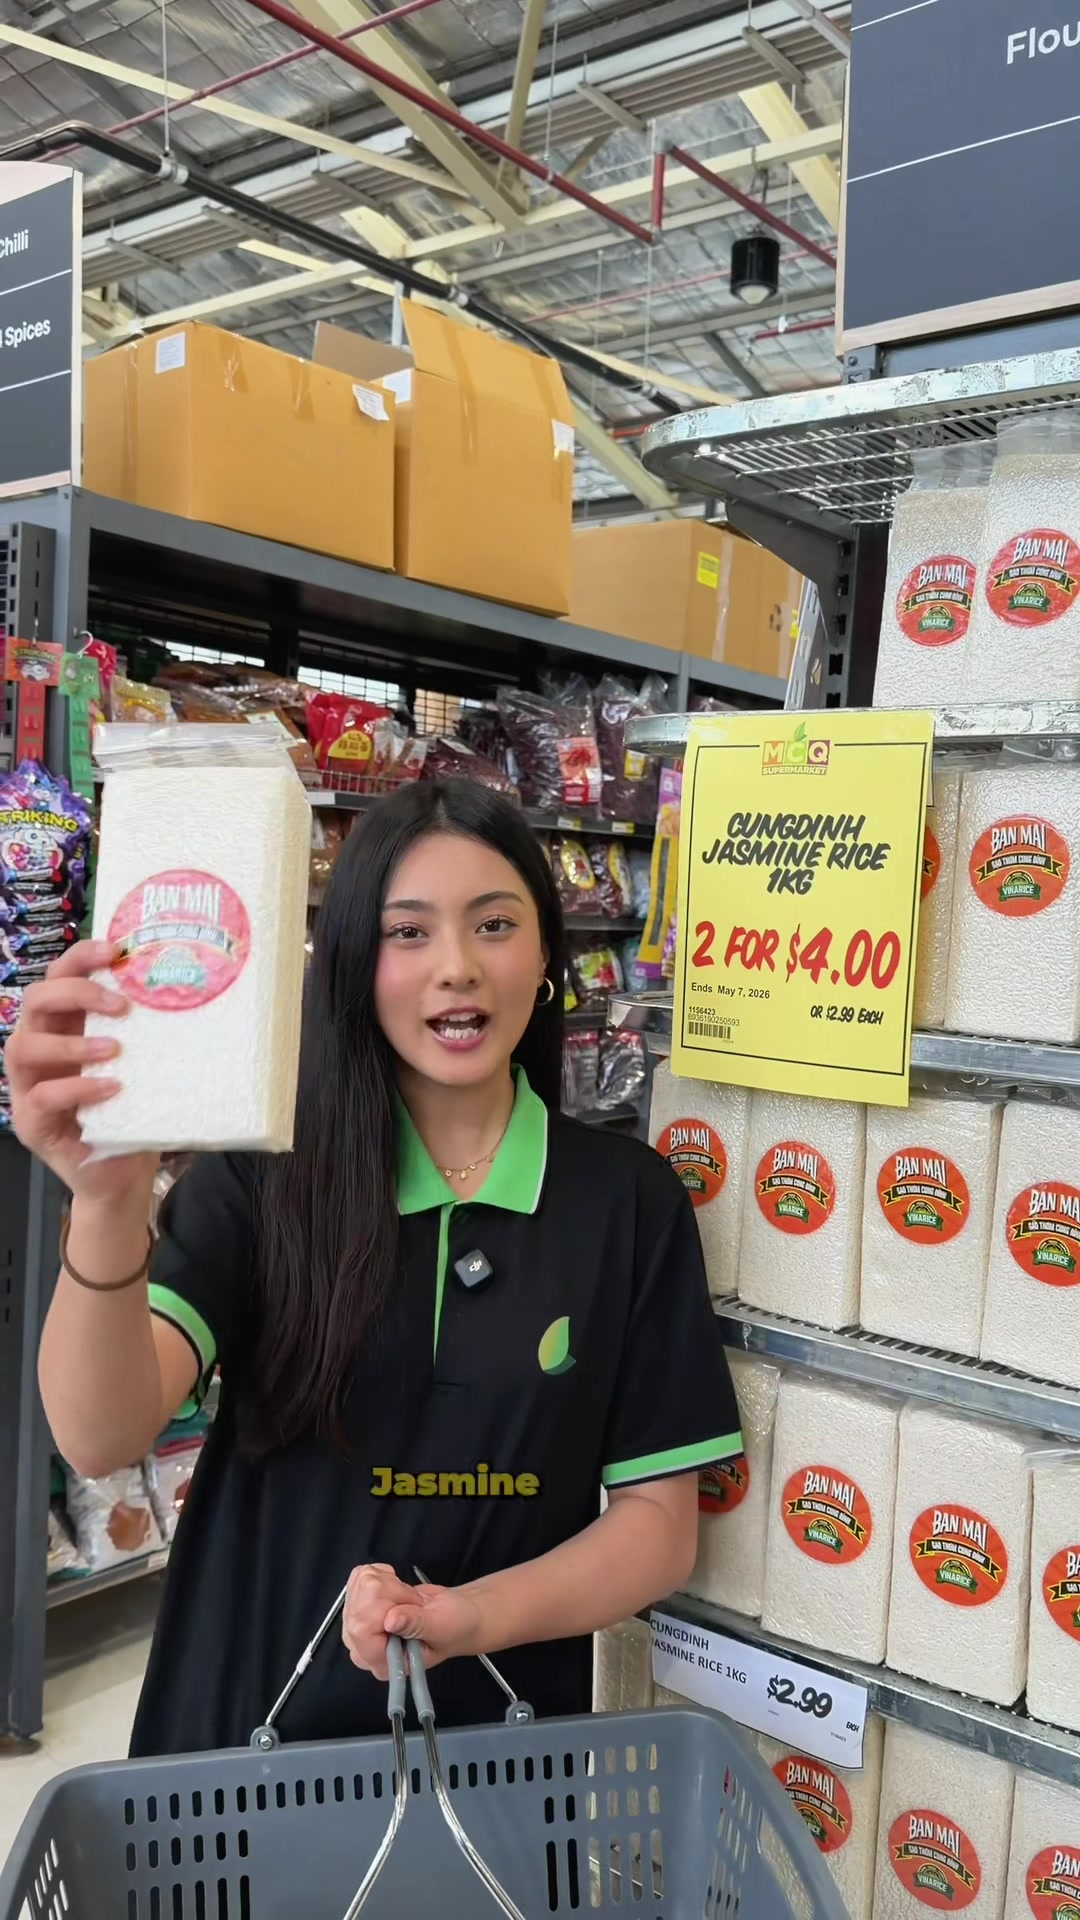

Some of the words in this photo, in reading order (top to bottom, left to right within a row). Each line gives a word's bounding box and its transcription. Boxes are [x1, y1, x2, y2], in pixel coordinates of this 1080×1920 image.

[1007, 21, 1080, 65] Flou
[5, 319, 51, 348] Spices
[1013, 538, 1042, 563] BAN
[1044, 538, 1069, 567] MAI
[918, 565, 943, 590] BAN
[944, 564, 967, 590] MAI
[1013, 595, 1044, 607] VINARICE
[922, 618, 950, 628] VINARICE
[763, 740, 829, 765] MCQ
[762, 766, 826, 775] SUPERMARKET
[0, 810, 79, 833] TRIKING
[727, 812, 866, 842] CUNGDINH
[990, 826, 1018, 855] BAN
[1020, 824, 1046, 852] MAI
[702, 839, 825, 867] JASMINE
[826, 842, 891, 871] RICE
[767, 868, 814, 895] 1KG
[1002, 886, 1034, 895] VINARICE
[143, 884, 181, 927] BAN
[184, 883, 221, 927] MAI
[692, 921, 715, 967] 2
[724, 926, 780, 972] FOR
[786, 923, 901, 989] $4.00
[691, 982, 713, 993] Ends
[718, 985, 736, 998] May
[738, 988, 746, 998] 7,
[748, 988, 770, 999] 2026
[688, 1013, 740, 1026] 8936190250593
[689, 1006, 716, 1016] 1156423
[810, 1005, 823, 1018] OR
[826, 1004, 854, 1023] $2.99
[858, 1008, 884, 1025] EACH
[670, 1127, 689, 1151] BAN
[691, 1128, 710, 1153] MAI
[773, 1149, 795, 1173] BAN
[798, 1152, 818, 1182] MAI
[896, 1156, 919, 1182] BAN
[922, 1158, 946, 1188] MAI
[778, 1204, 804, 1217] VINARICE
[1028, 1189, 1057, 1216] BAN
[1060, 1194, 1080, 1222] MA
[907, 1213, 936, 1226] VINARICE
[1037, 1251, 1070, 1266] VINARICE
[804, 1470, 828, 1495] BAN
[831, 1481, 856, 1514] MAI
[808, 1528, 837, 1546] VINARICE
[932, 1510, 959, 1536] BAN
[962, 1517, 988, 1551] MAI
[940, 1570, 971, 1586] VINARICE
[650, 1619, 710, 1650] CUNGDINH
[698, 1656, 723, 1674] RICE
[726, 1666, 747, 1684] 1KG
[767, 1674, 832, 1718] $2.99
[786, 1761, 810, 1786] BAN
[812, 1771, 834, 1803] MAI
[908, 1815, 933, 1840] BAN
[936, 1824, 960, 1858] MAI
[1051, 1850, 1080, 1878] BAN
[918, 1874, 947, 1892] VINARICE
